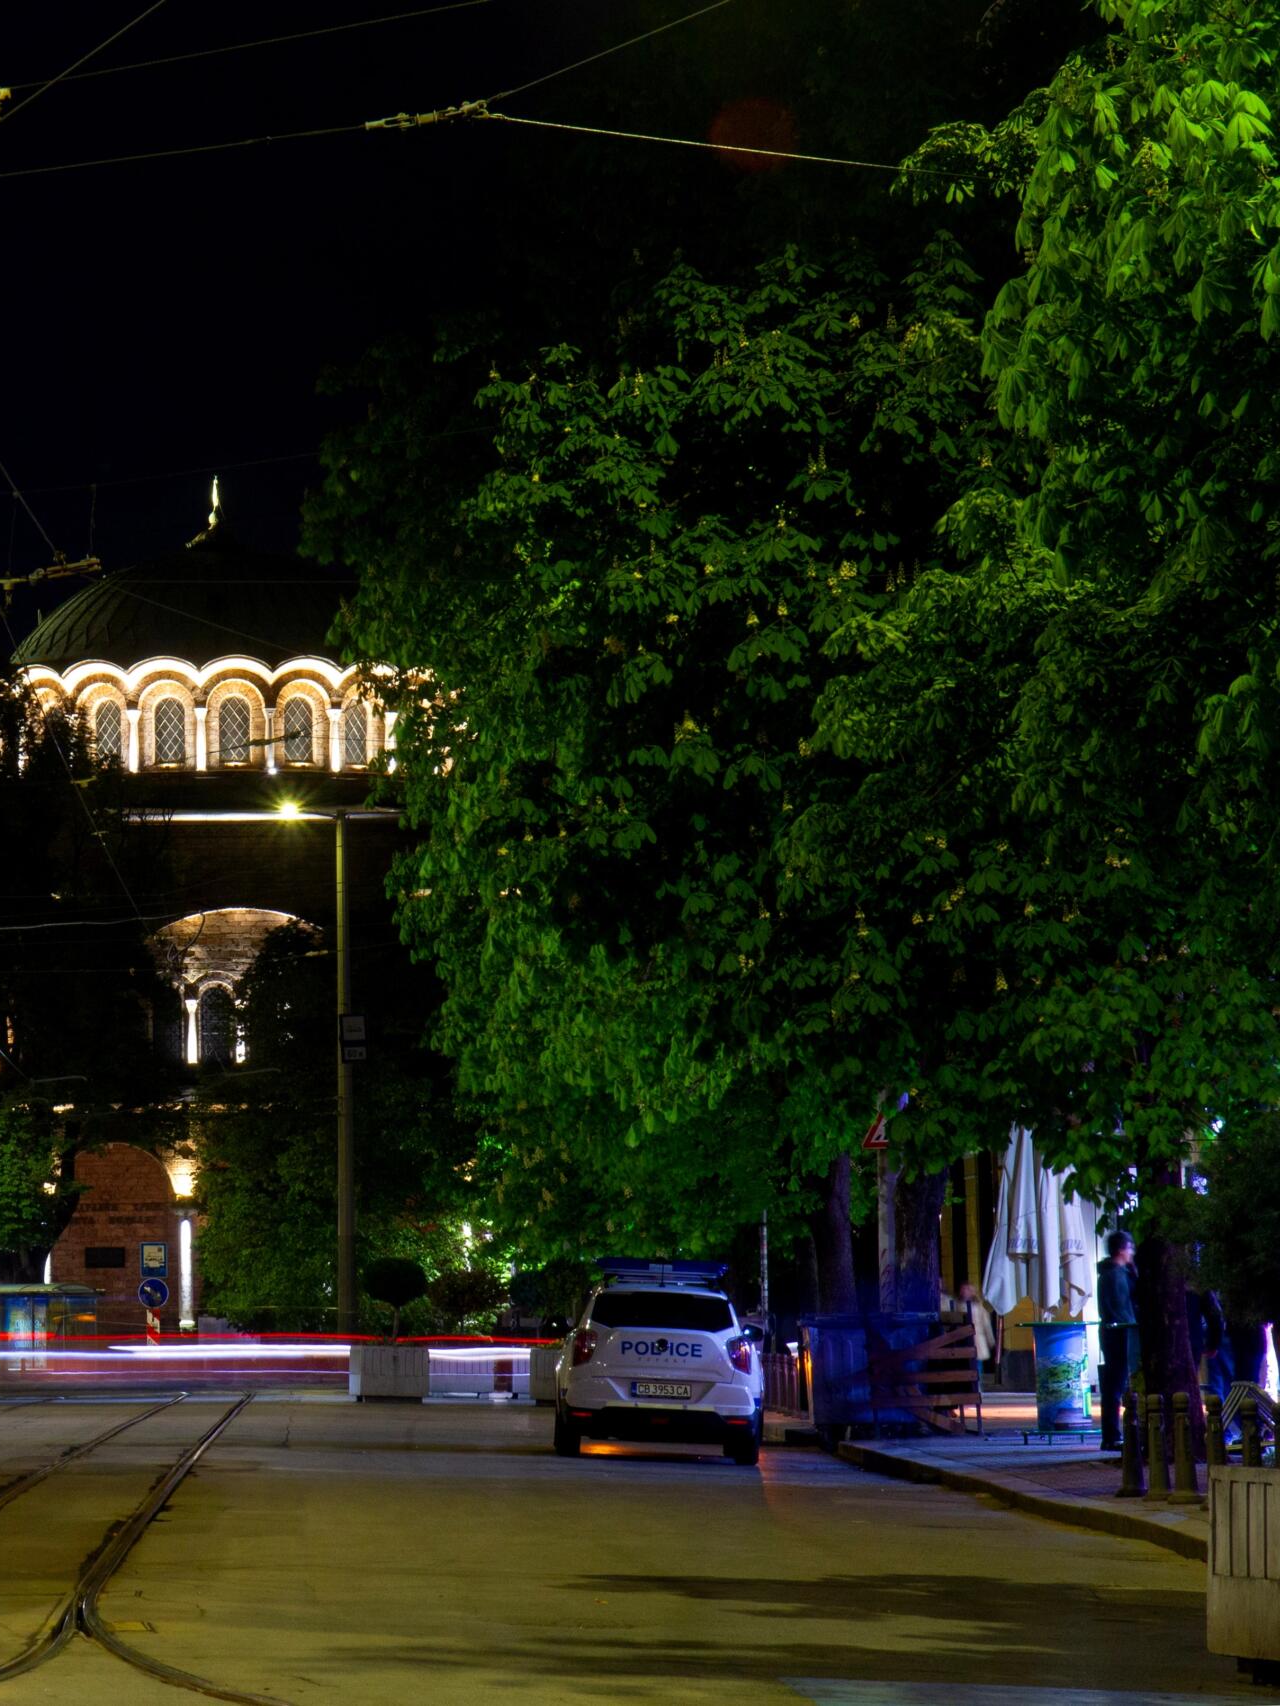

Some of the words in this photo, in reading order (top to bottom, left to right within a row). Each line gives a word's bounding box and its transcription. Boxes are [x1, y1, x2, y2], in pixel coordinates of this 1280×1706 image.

[621, 1340, 703, 1358] POLICE
[637, 1383, 650, 1394] CB
[652, 1383, 675, 1396] 3953
[676, 1385, 689, 1397] CA
